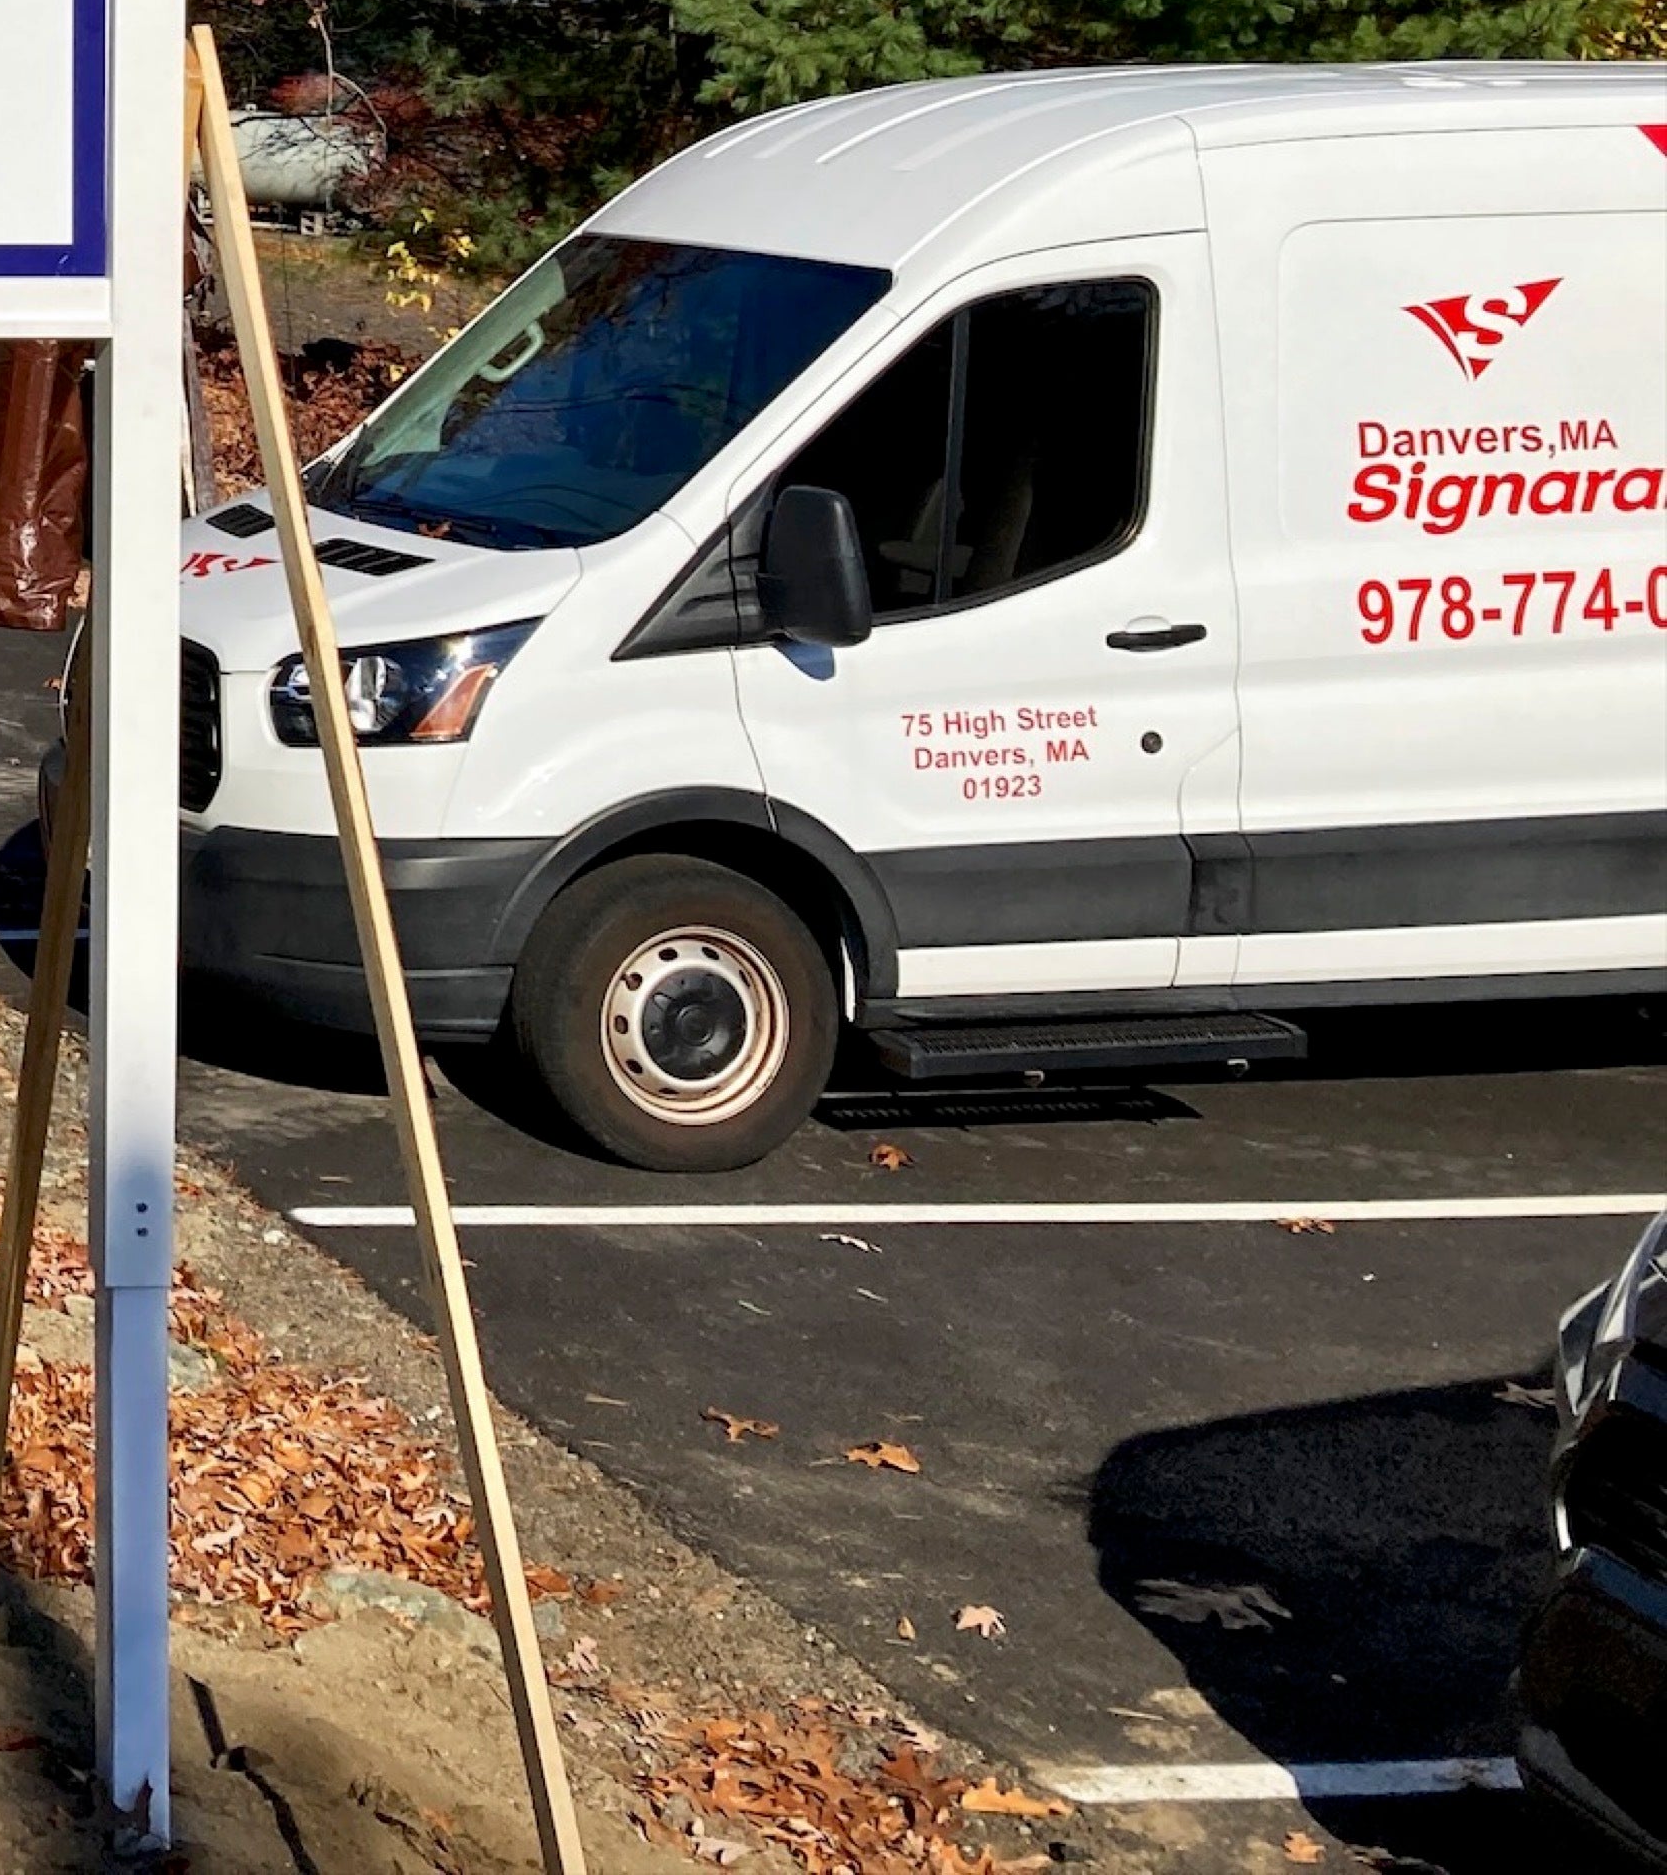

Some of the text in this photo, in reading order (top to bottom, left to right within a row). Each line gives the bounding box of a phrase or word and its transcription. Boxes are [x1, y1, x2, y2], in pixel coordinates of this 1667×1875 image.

[1345, 460, 1667, 536] Signara
[901, 705, 1098, 739] 75 High Street
[914, 739, 1090, 770] Danvers, MA
[962, 774, 1042, 800] 01923
